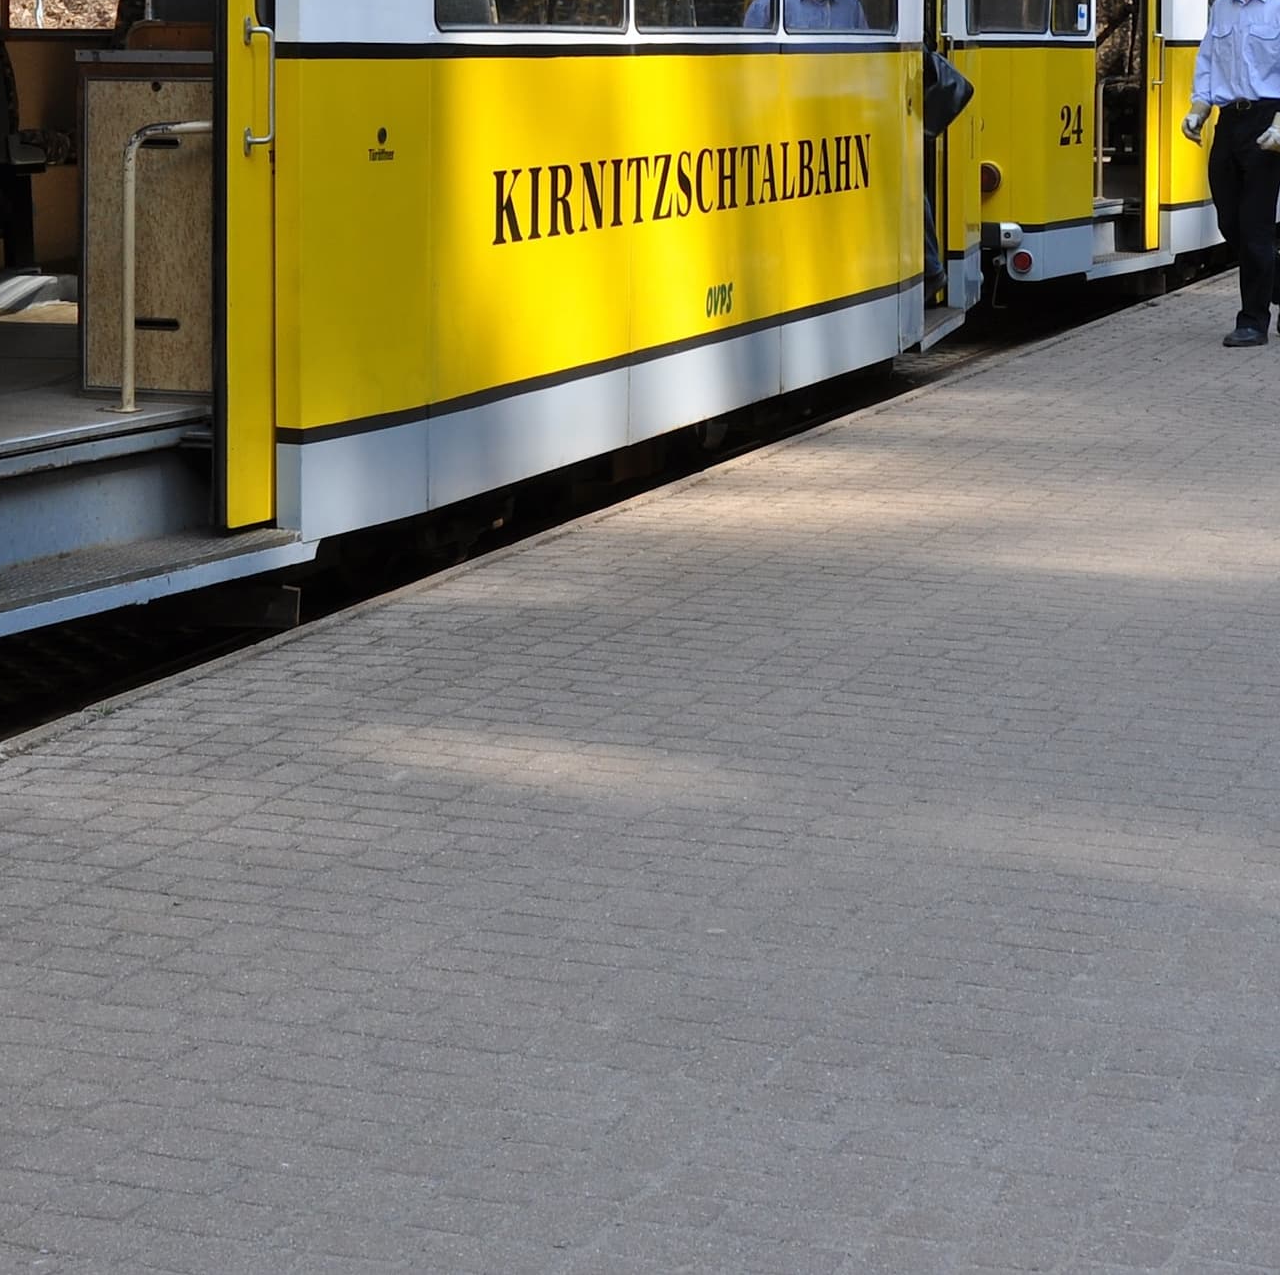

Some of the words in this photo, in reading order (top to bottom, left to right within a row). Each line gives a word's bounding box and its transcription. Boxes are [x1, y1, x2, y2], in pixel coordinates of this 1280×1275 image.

[1060, 104, 1083, 146] 24
[492, 133, 872, 246] KIRNITZSCHTALBAHN
[706, 281, 733, 318] OVPS
